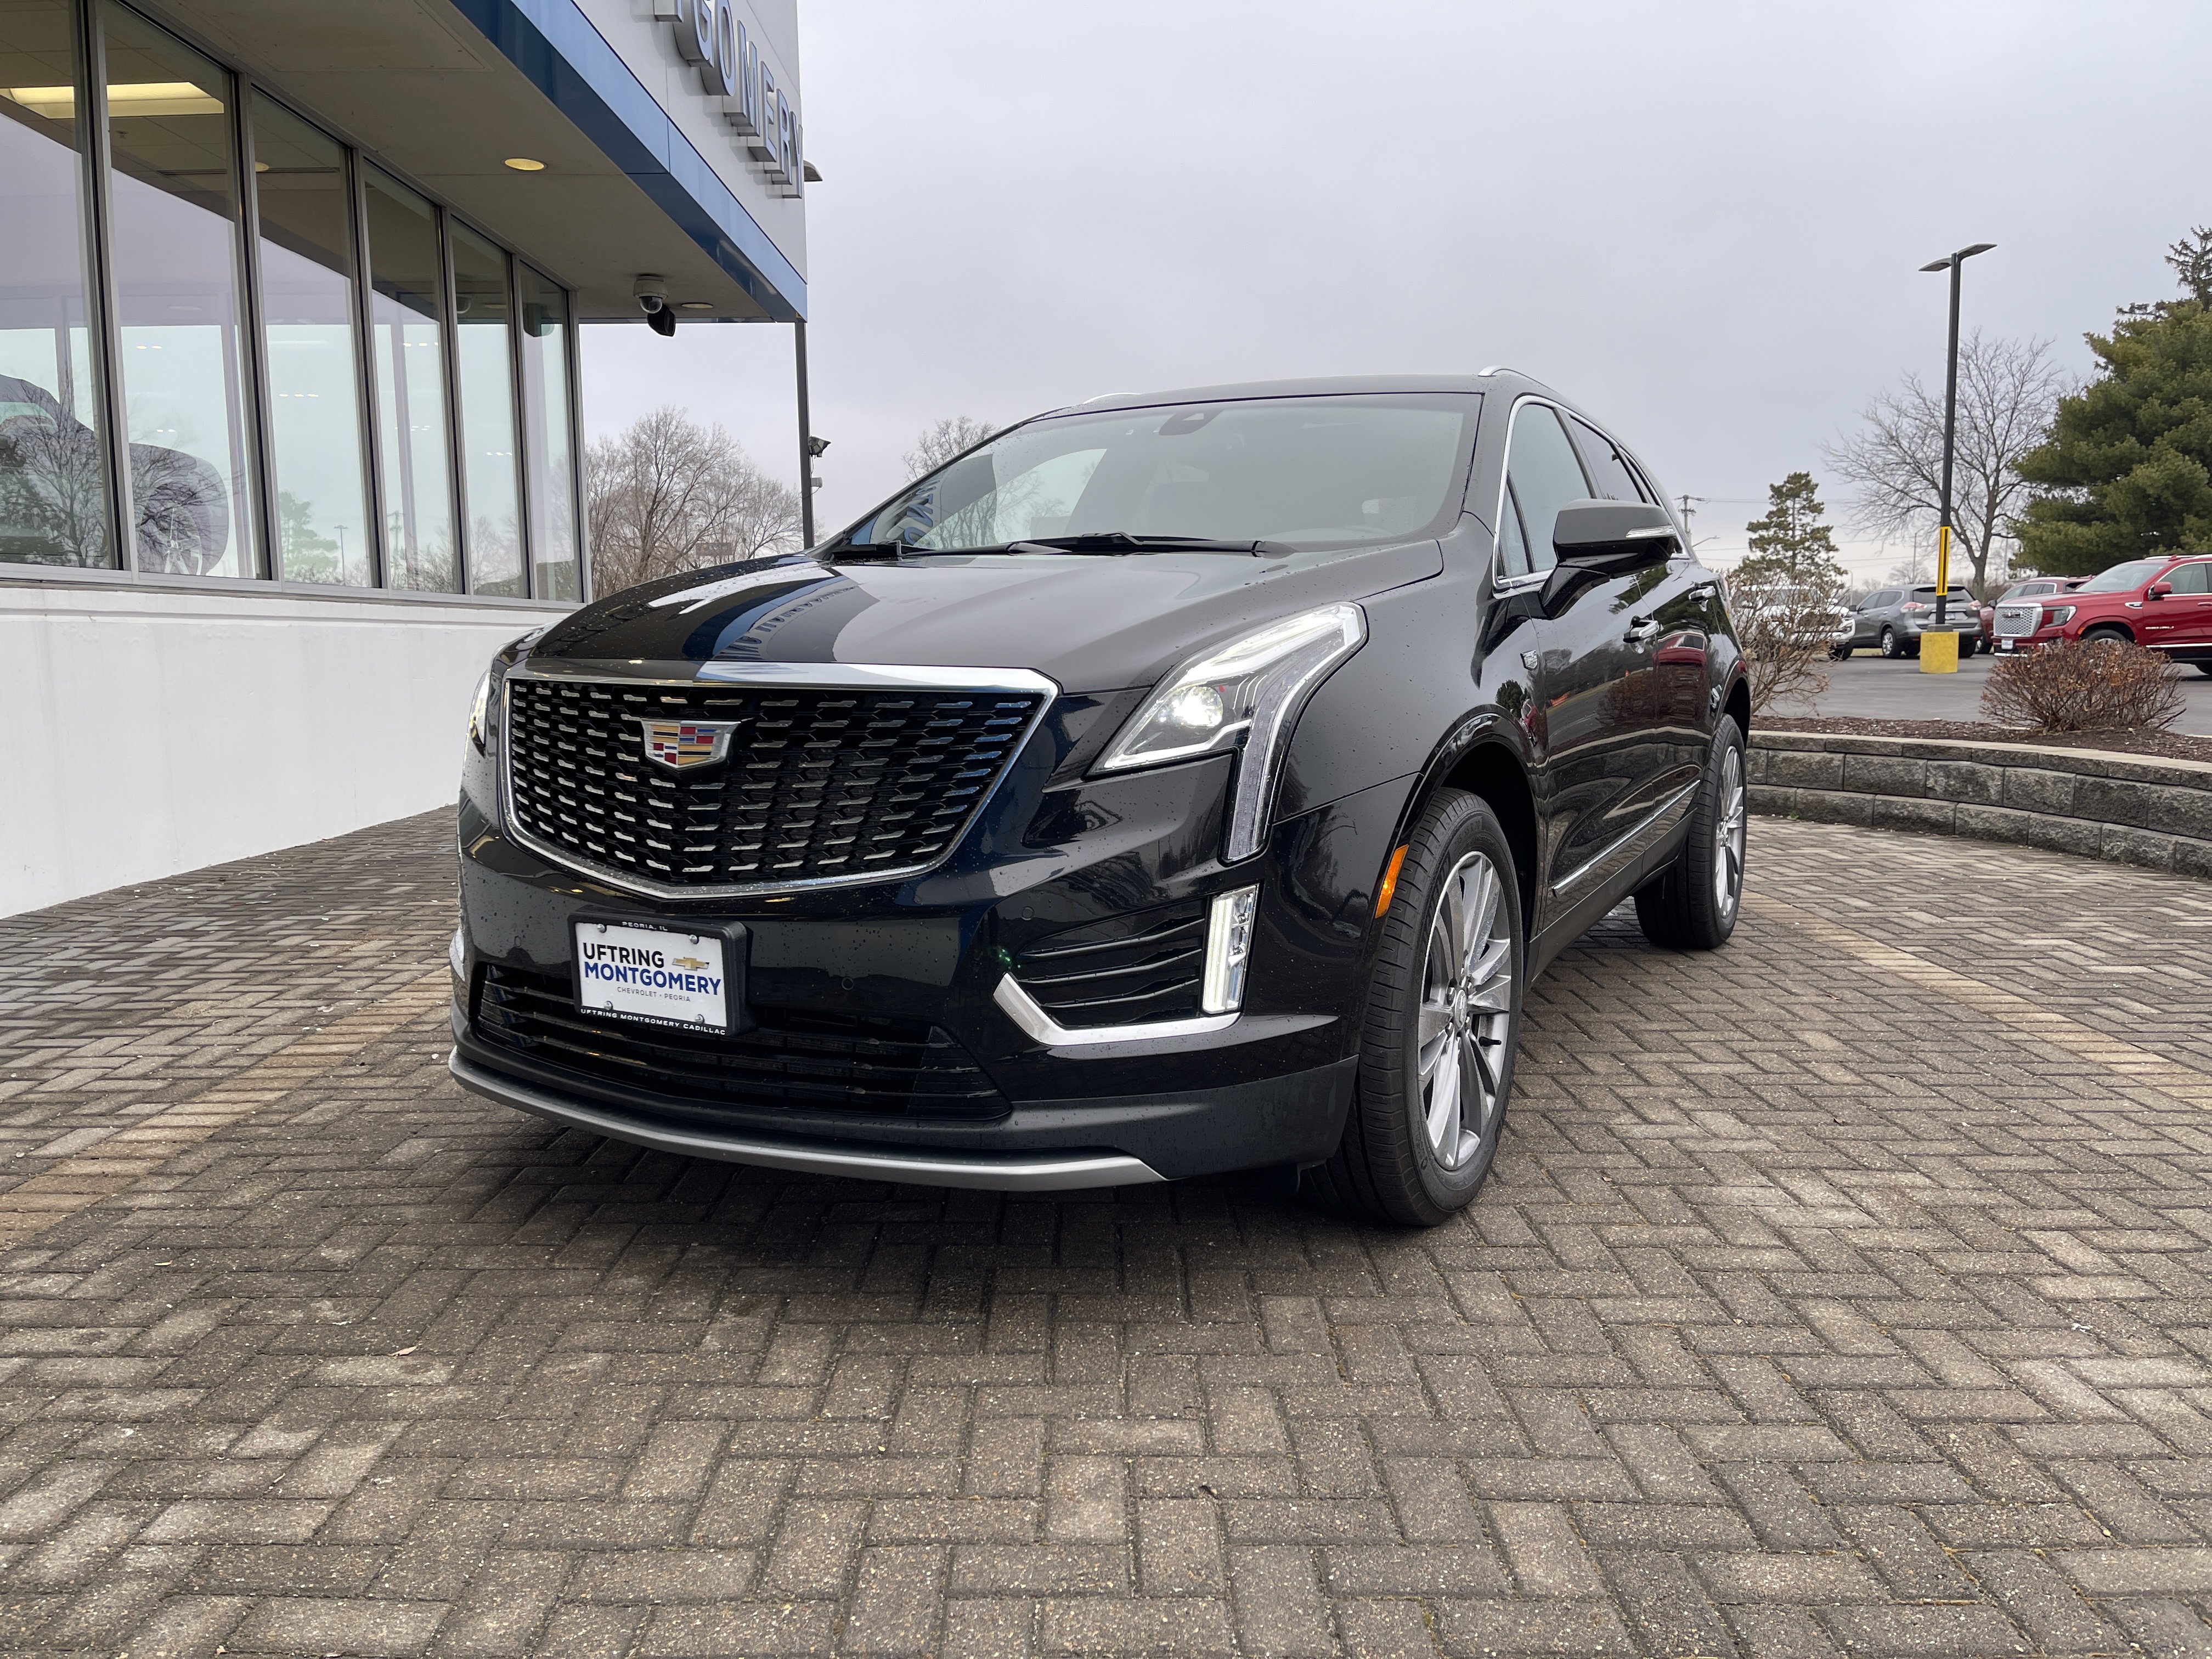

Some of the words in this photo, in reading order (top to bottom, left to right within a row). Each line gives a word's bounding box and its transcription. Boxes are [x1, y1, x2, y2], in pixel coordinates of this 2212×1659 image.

[583, 942, 664, 968] UFTRING
[584, 961, 721, 995] MONTGOMERY
[617, 986, 657, 997] CHEVROLET
[664, 993, 691, 1002] PEORIA
[580, 1008, 618, 1018] UFTRING
[620, 1014, 680, 1028] MONTGOMERY
[682, 1023, 726, 1035] CADILLAC
